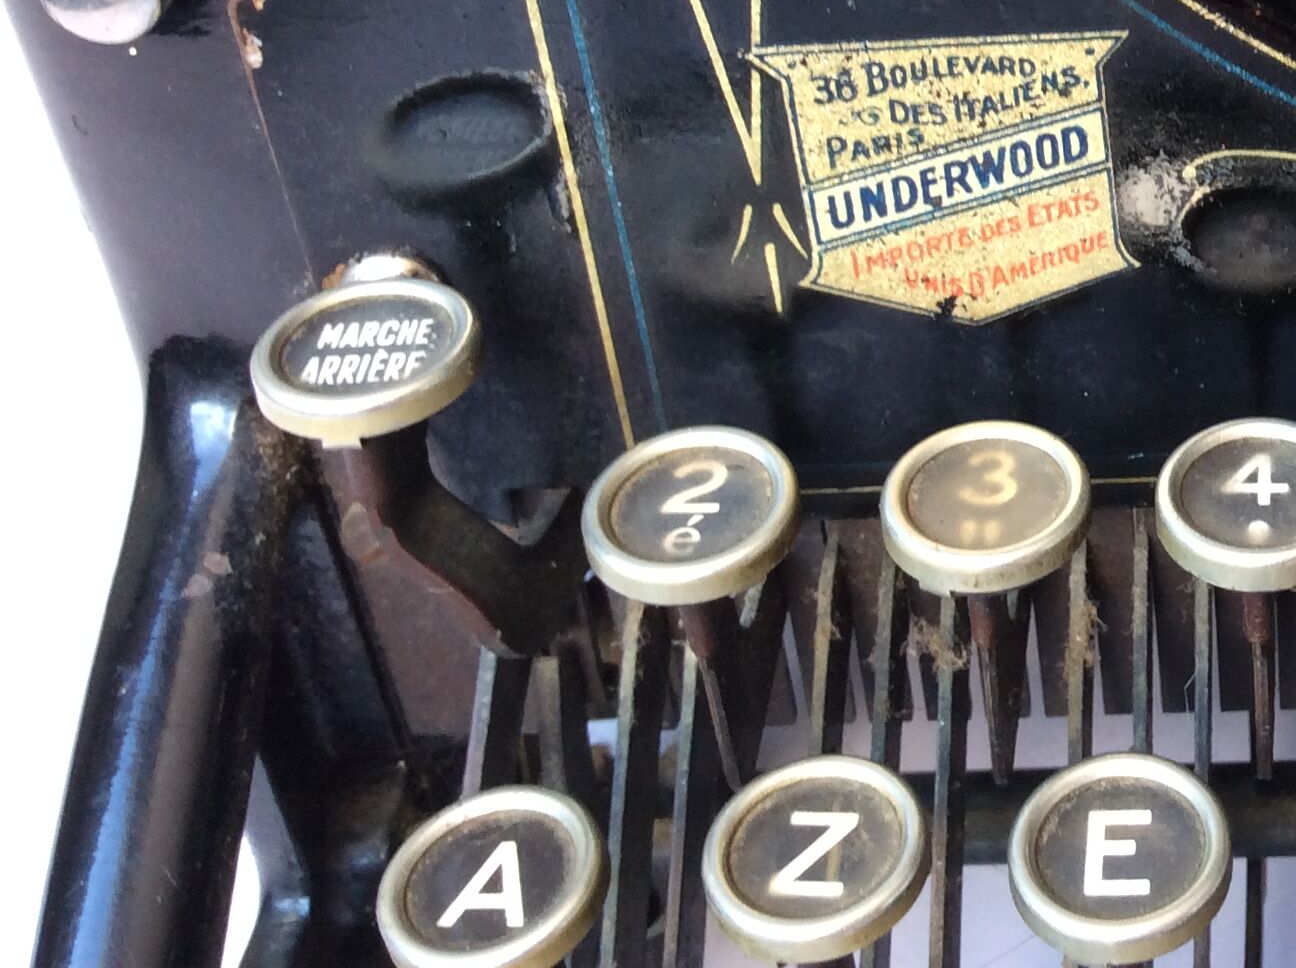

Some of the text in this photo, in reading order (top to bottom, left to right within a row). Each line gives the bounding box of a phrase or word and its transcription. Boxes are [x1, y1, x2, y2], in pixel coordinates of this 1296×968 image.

[861, 56, 1036, 97] BOULEVARD
[889, 99, 948, 125] DES
[826, 128, 925, 169] PARIS
[827, 126, 1089, 229] UNDERWOOD
[317, 318, 435, 350] MARCHE
[661, 461, 729, 514] 2
[958, 450, 1018, 507] 3
[1220, 452, 1290, 506] 4
[768, 811, 860, 898] Z
[1083, 810, 1153, 897] E
[436, 840, 525, 928] A
